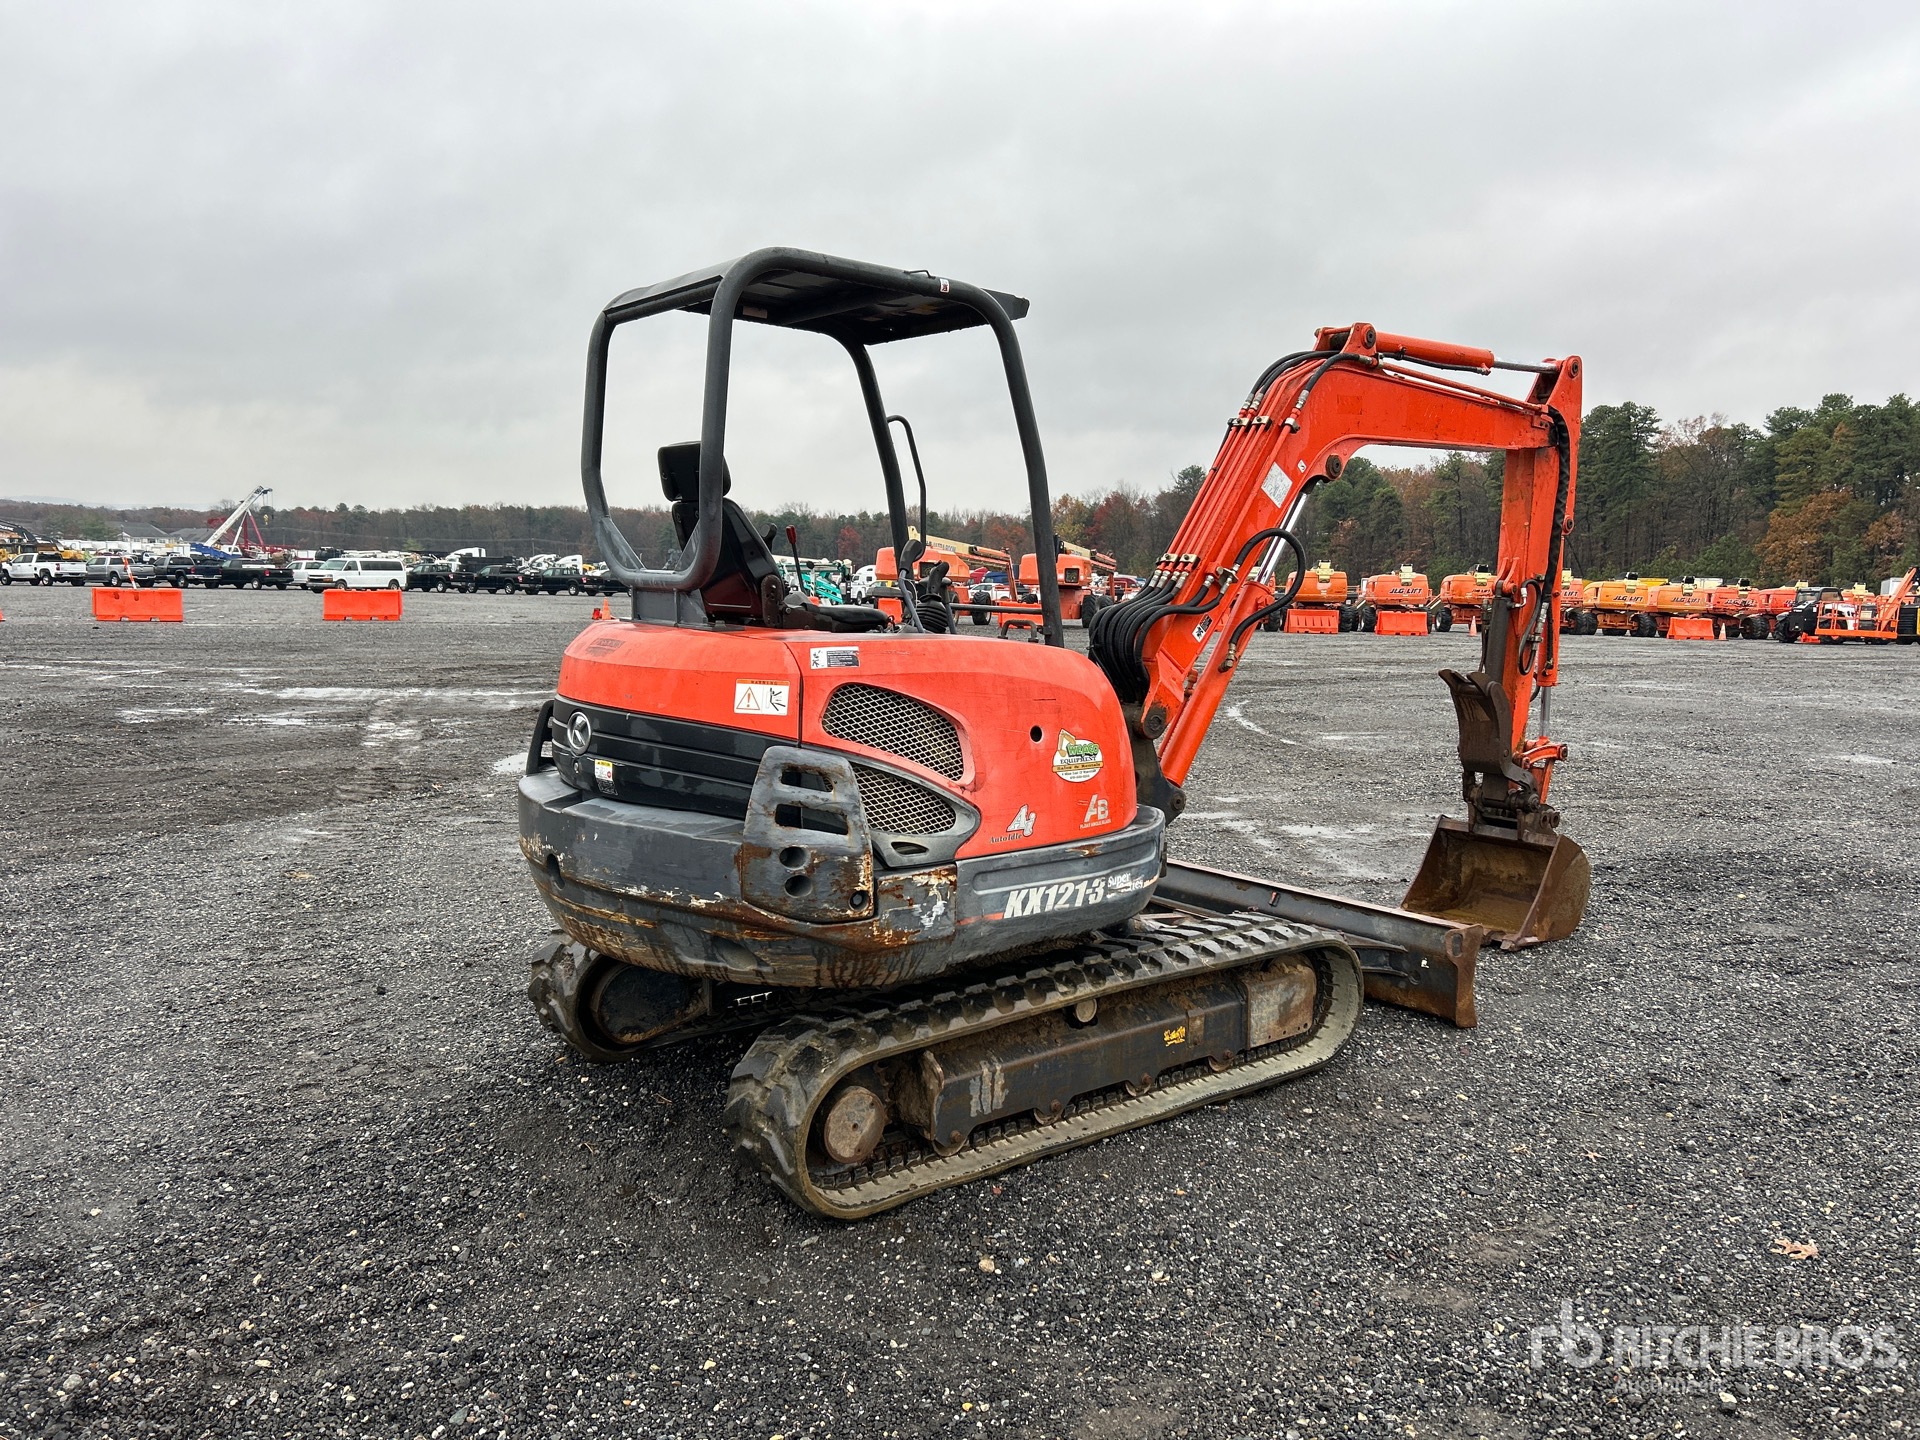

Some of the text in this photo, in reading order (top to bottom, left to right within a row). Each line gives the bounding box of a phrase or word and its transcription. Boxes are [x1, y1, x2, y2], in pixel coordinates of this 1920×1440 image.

[1060, 756, 1096, 765] EQUIPMENT
[1108, 872, 1131, 888] Super
[1003, 876, 1105, 919] KX121-3
